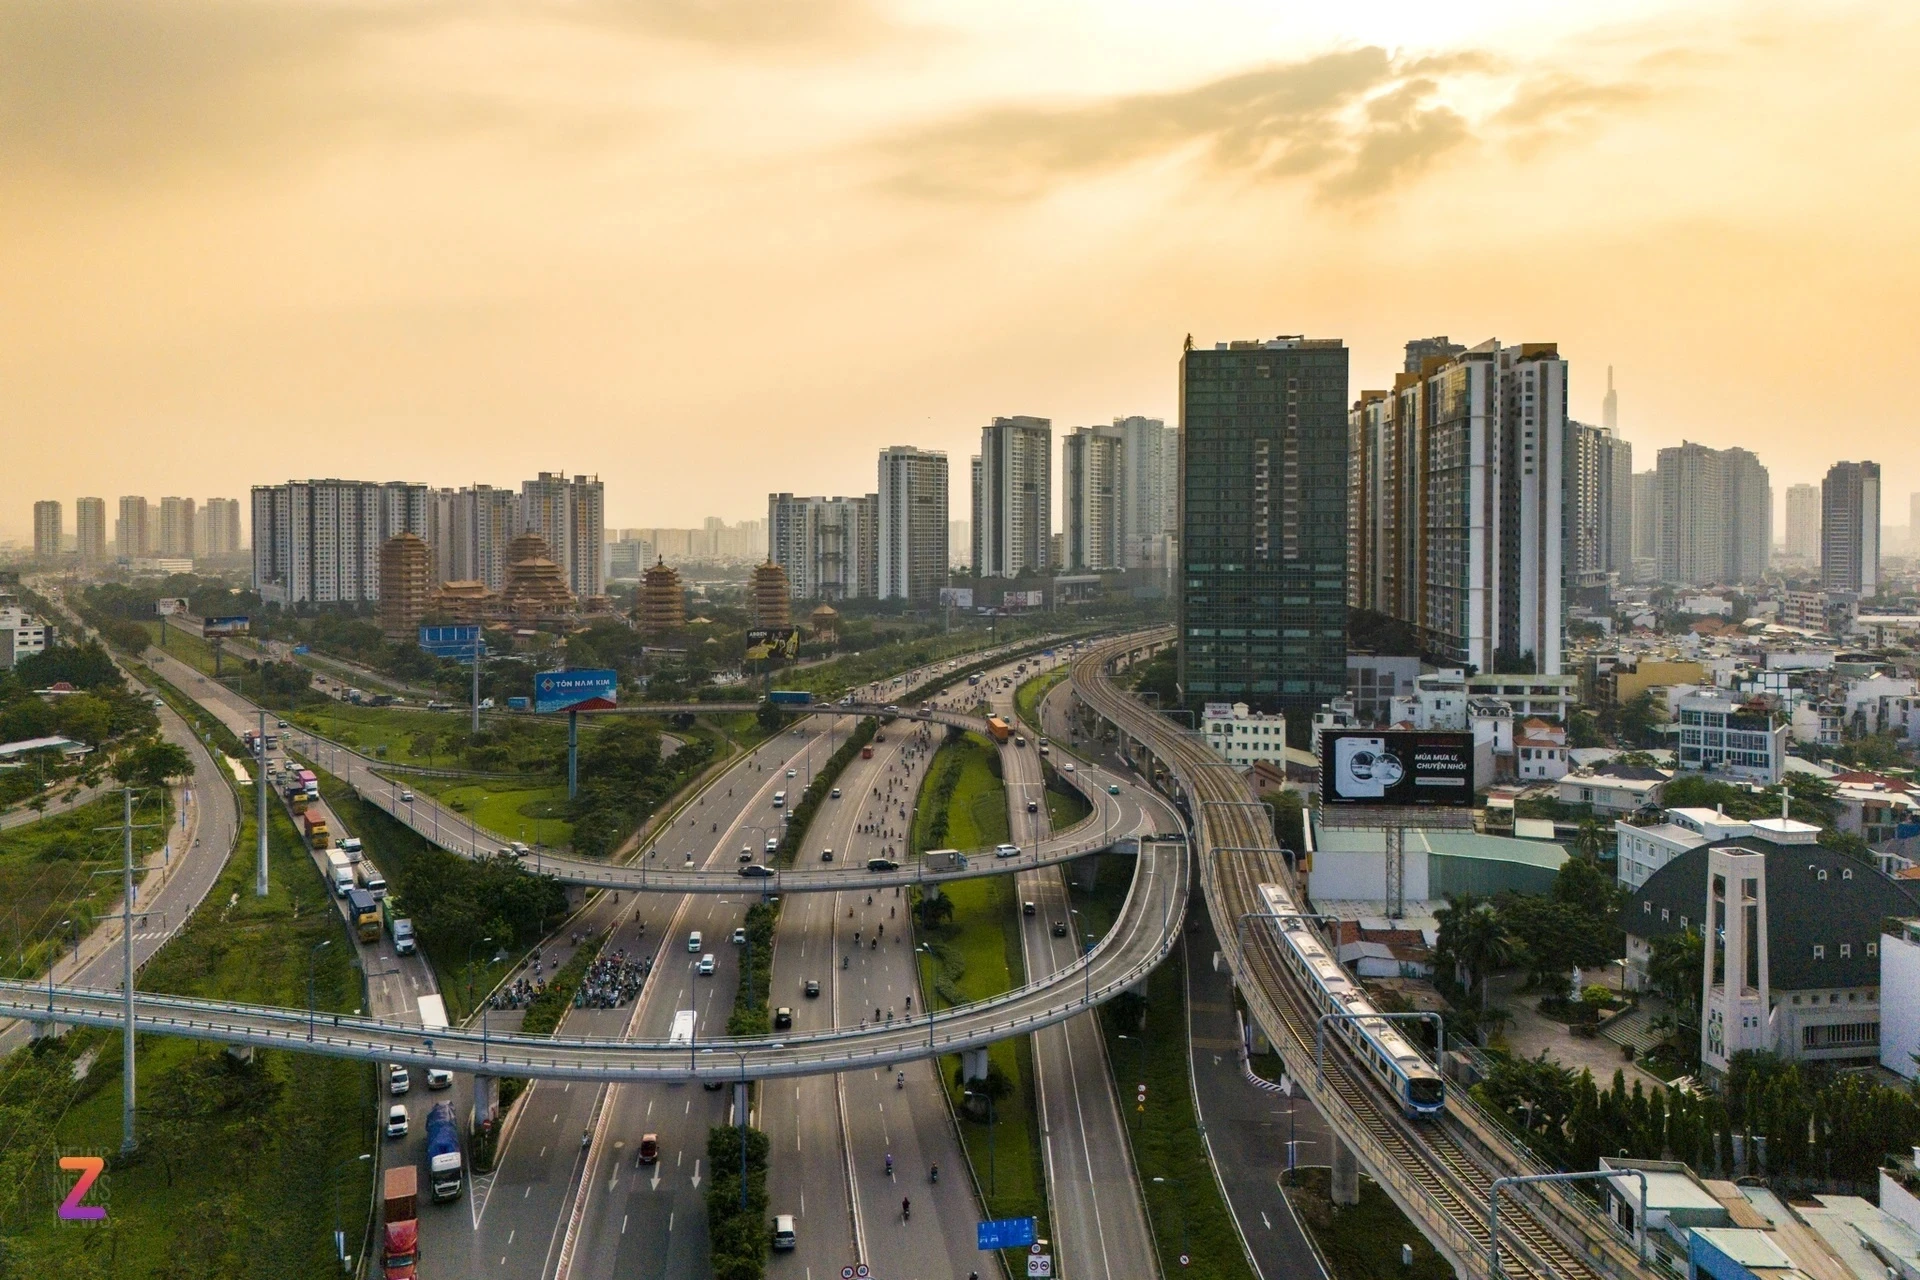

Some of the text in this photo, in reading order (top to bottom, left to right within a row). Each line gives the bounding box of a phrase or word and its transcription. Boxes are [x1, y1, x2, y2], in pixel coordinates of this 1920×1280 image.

[556, 678, 610, 688] TÔN NAM KIM
